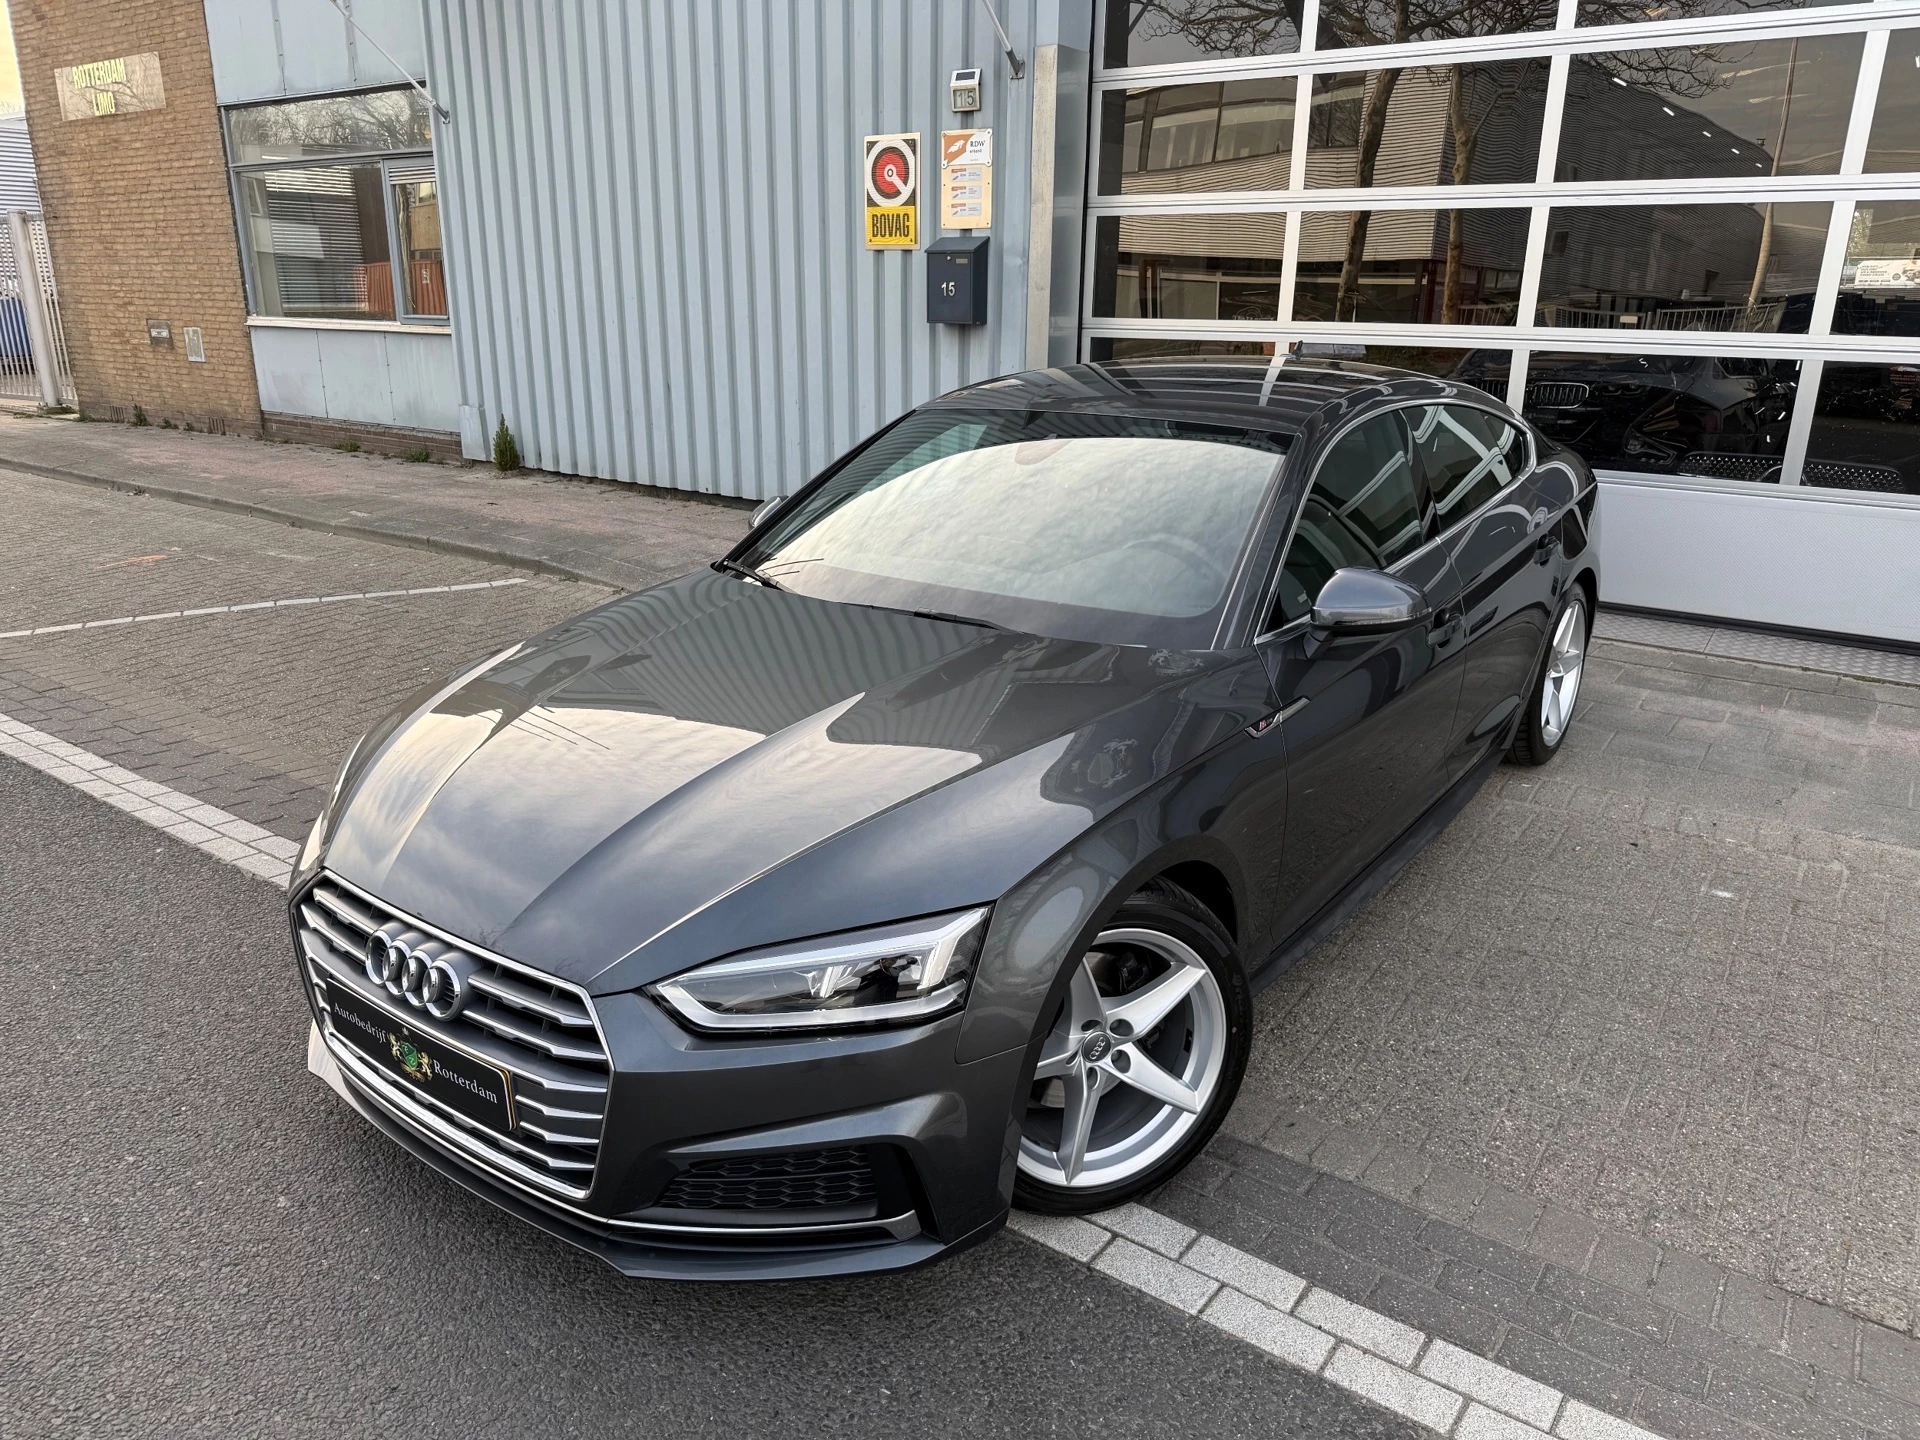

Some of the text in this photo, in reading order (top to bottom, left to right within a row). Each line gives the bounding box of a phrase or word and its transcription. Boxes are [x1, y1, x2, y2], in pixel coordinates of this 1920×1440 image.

[72, 58, 126, 89] ROTTERDAM
[92, 91, 116, 116] LIMO
[958, 90, 975, 107] 15
[871, 213, 910, 238] BOVAG
[941, 281, 955, 296] 15
[334, 1002, 498, 1104] Autobedrijf Rotterdam
